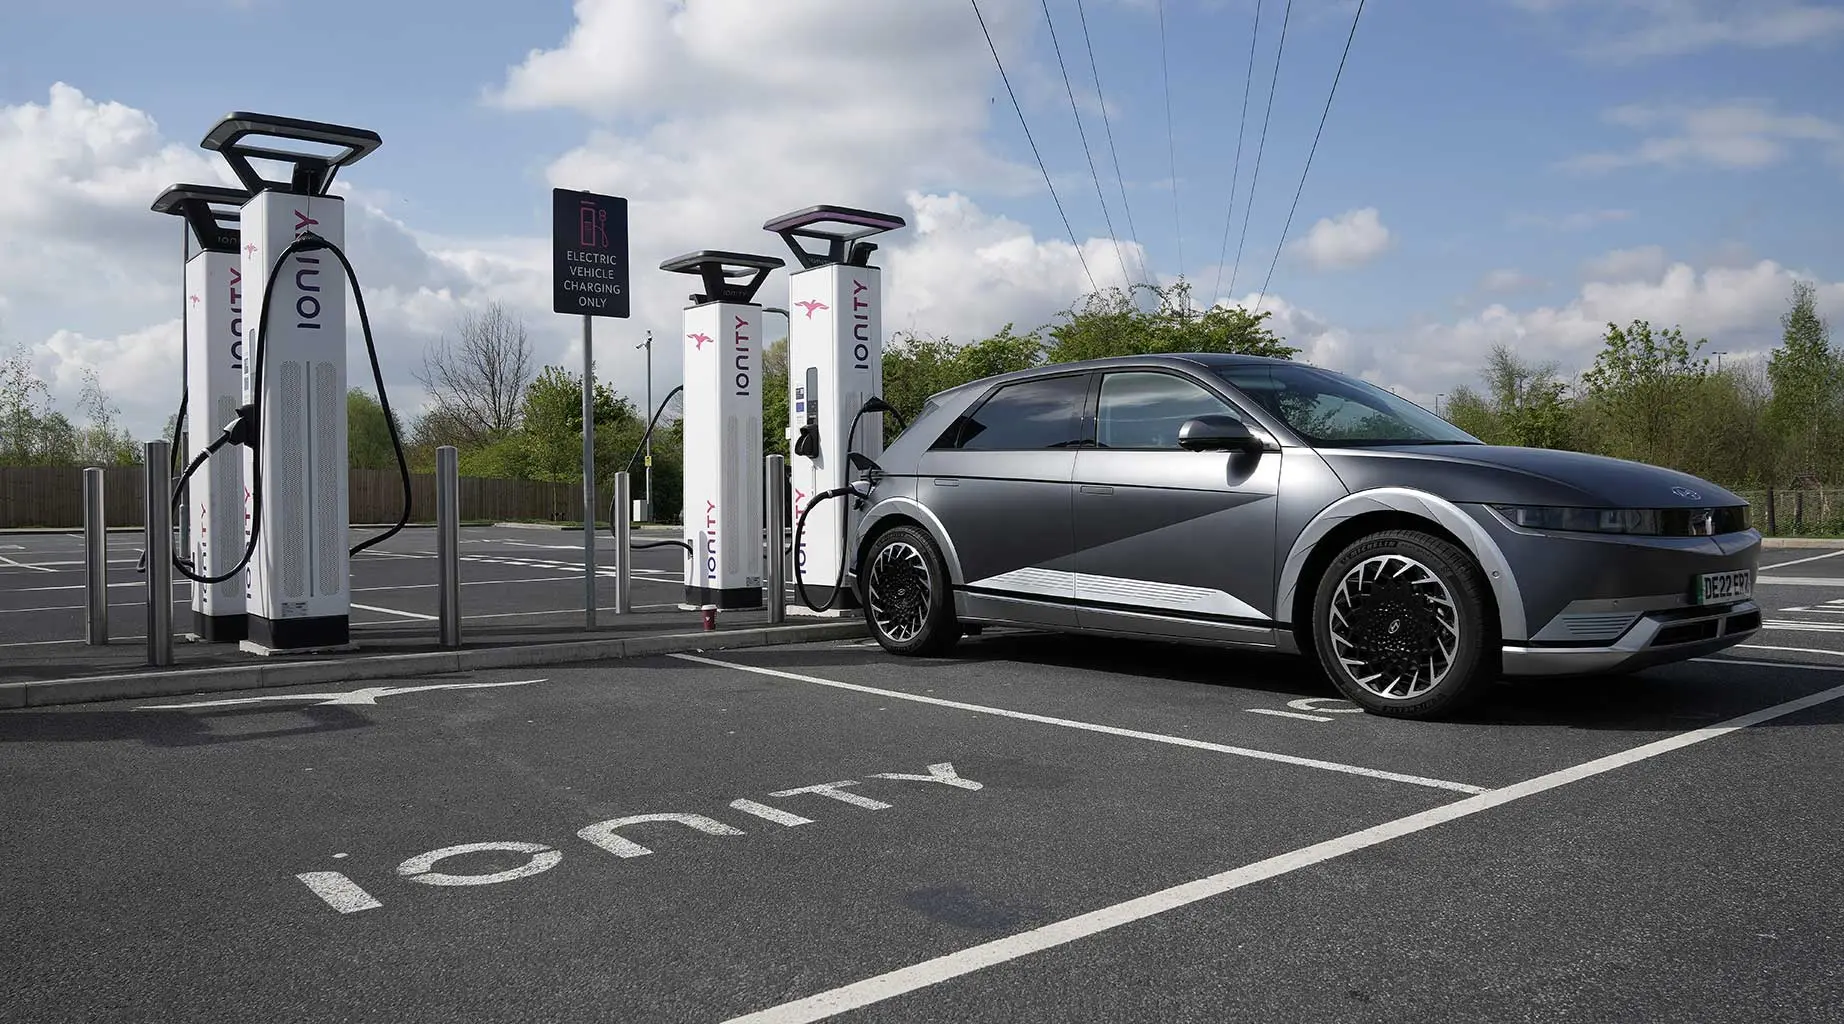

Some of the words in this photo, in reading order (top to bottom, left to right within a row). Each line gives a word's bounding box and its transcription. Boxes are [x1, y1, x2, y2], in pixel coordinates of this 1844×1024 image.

[295, 210, 321, 329] IONIY
[567, 250, 617, 265] ELECTRIC
[569, 266, 615, 279] VEHICLE
[563, 280, 621, 295] CHARGING
[578, 296, 607, 308] ONLY
[853, 279, 869, 370] IONITY
[735, 315, 750, 396] IONITY
[706, 500, 717, 579] IONITY
[1704, 575, 1732, 600] DE22
[296, 762, 984, 914] IONITY
